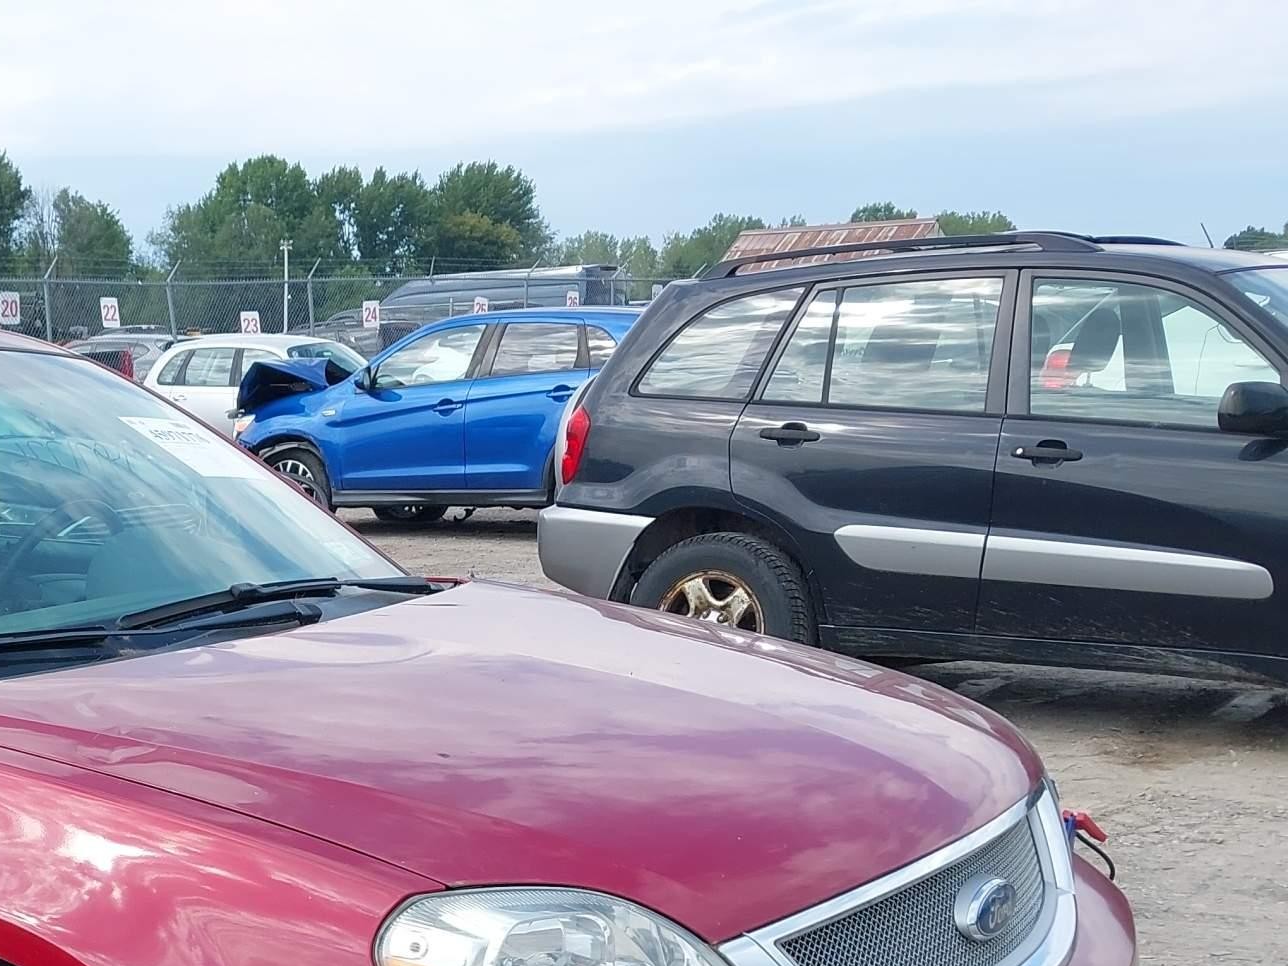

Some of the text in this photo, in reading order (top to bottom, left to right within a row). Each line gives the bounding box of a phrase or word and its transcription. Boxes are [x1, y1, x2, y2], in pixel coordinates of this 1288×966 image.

[1, 299, 18, 318] 20
[103, 304, 118, 322] 22
[364, 306, 378, 322] 24
[242, 318, 259, 334] 23
